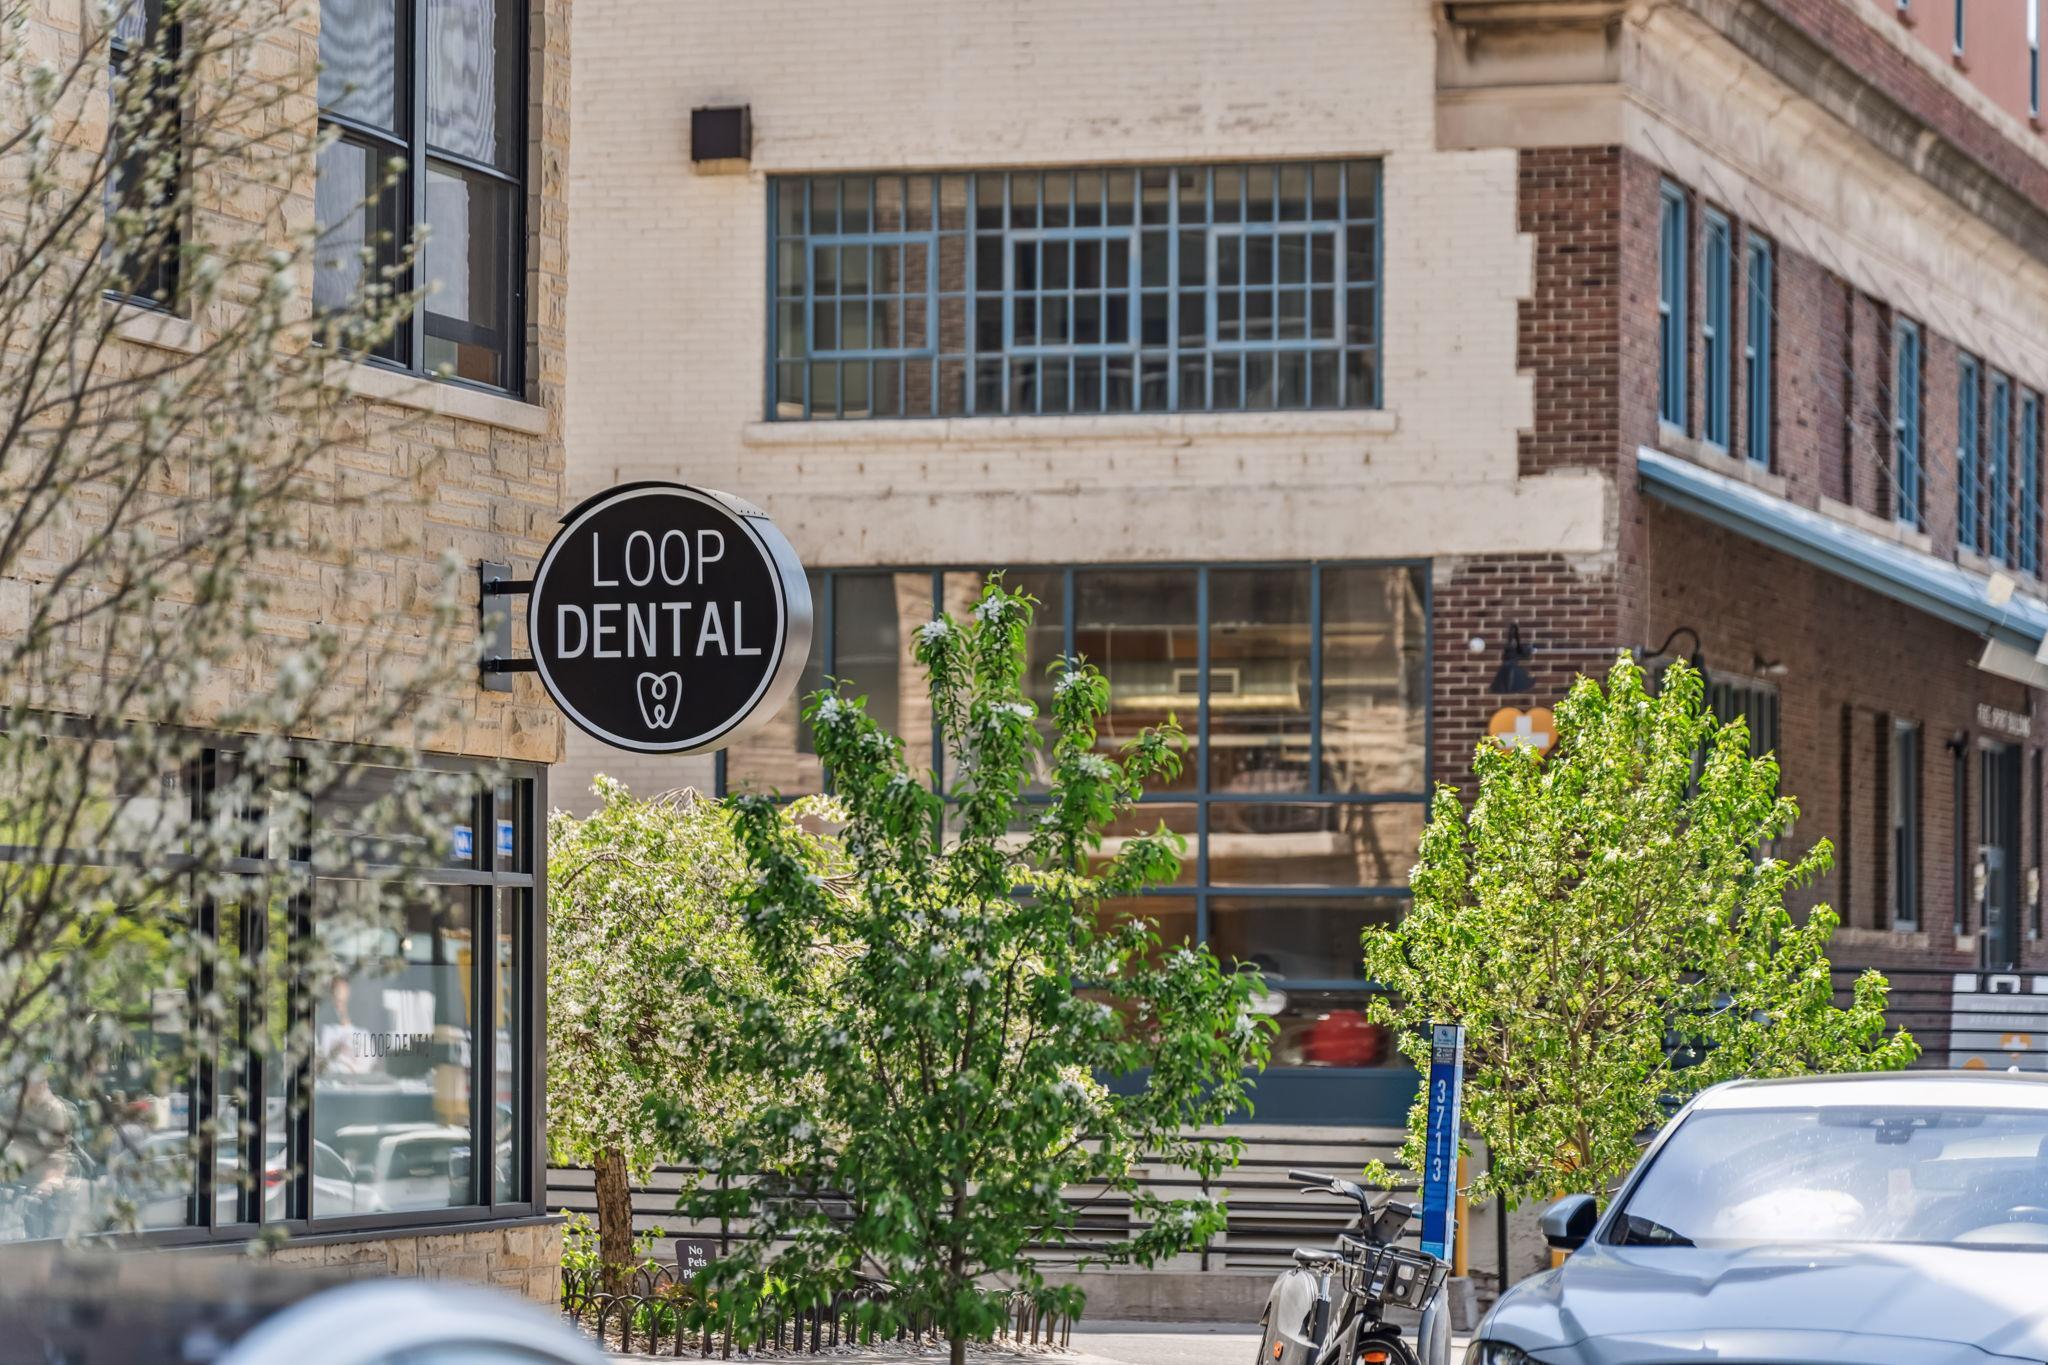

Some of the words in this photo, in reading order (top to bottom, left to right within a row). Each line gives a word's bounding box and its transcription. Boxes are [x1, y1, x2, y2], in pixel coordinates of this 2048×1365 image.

[593, 529, 725, 587] LOOP
[557, 600, 762, 659] DENTAL
[364, 1033, 390, 1057] LOOP
[1432, 1080, 1446, 1182] 3713
[687, 1257, 708, 1267] Pets
[688, 1245, 703, 1255] No
